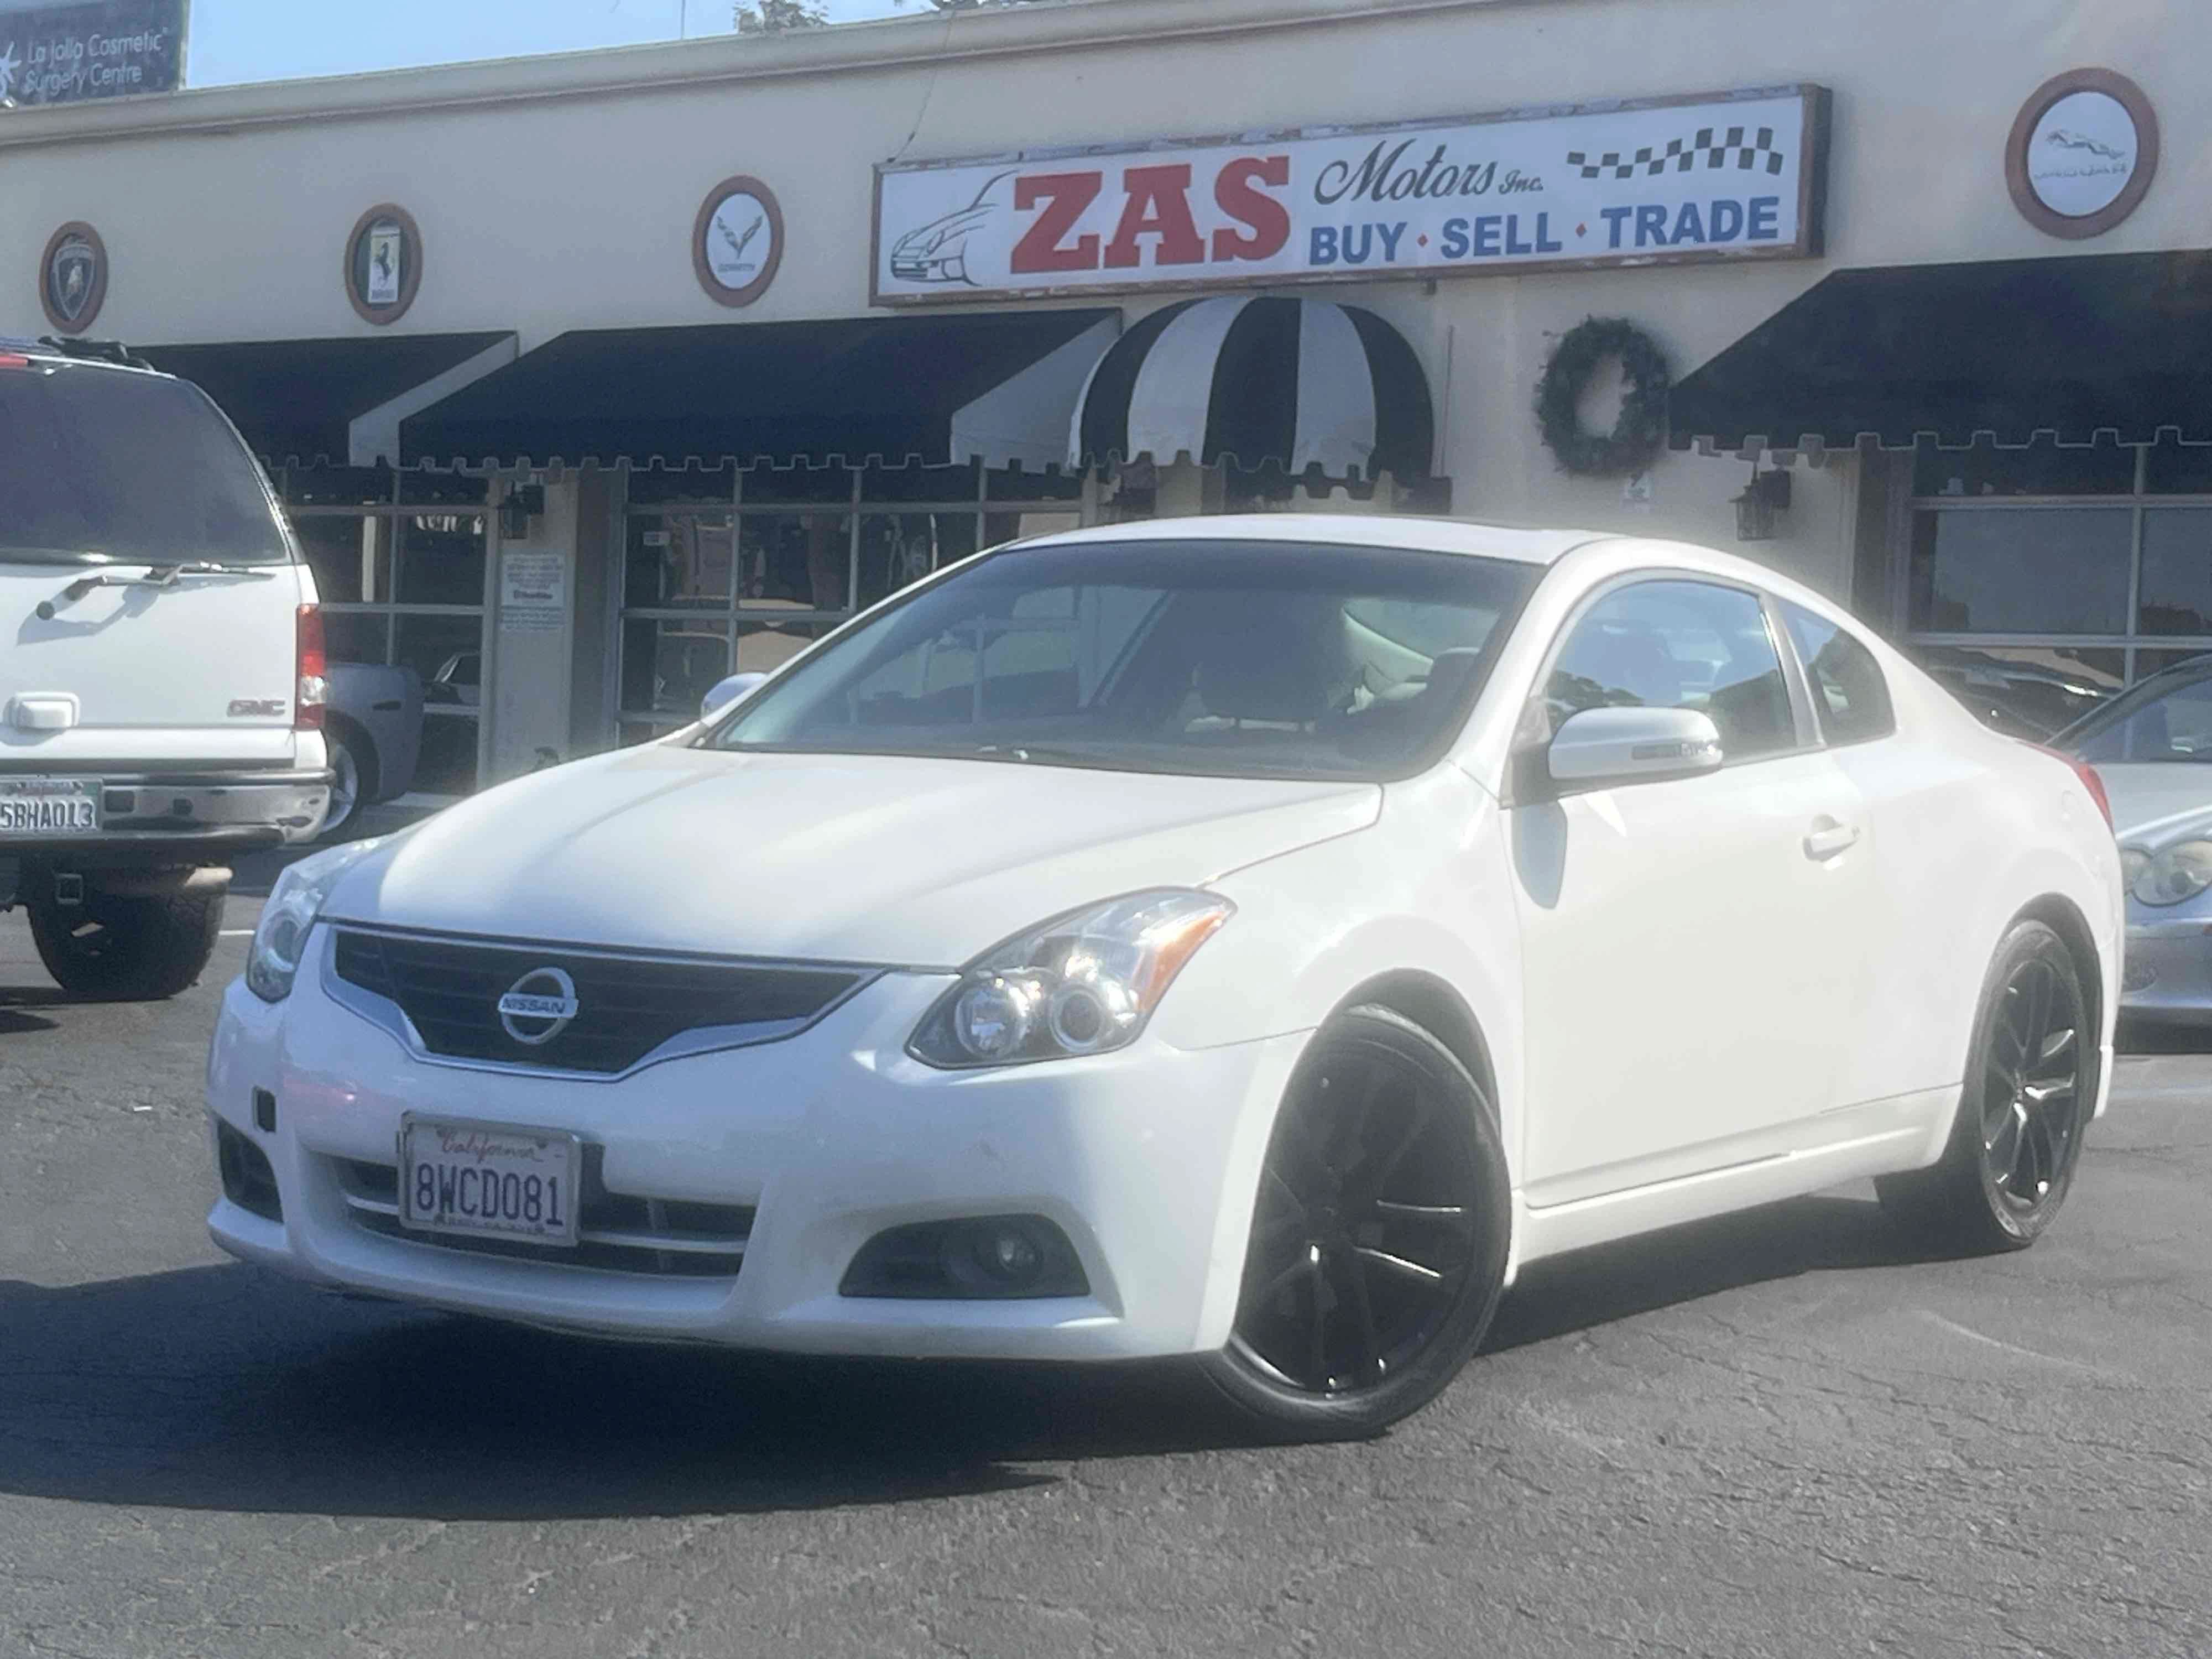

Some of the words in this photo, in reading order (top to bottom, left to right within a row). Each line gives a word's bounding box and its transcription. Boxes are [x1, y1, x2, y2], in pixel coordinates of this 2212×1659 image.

[28, 40, 46, 64] La
[49, 39, 83, 67] Jolla
[88, 30, 163, 56] Cosmetic
[22, 70, 87, 96] Surgery
[90, 62, 142, 86] Centre
[1313, 138, 1498, 205] Motors
[1498, 169, 1544, 196] Inc.
[1010, 155, 1291, 275] ZAS
[1308, 222, 1407, 266] BUY
[1439, 212, 1562, 259] SELL
[1600, 196, 1780, 249] TRADE
[227, 700, 285, 717] GMC
[0, 801, 96, 828] 5BHA013
[416, 1162, 564, 1227] 8WCD081
